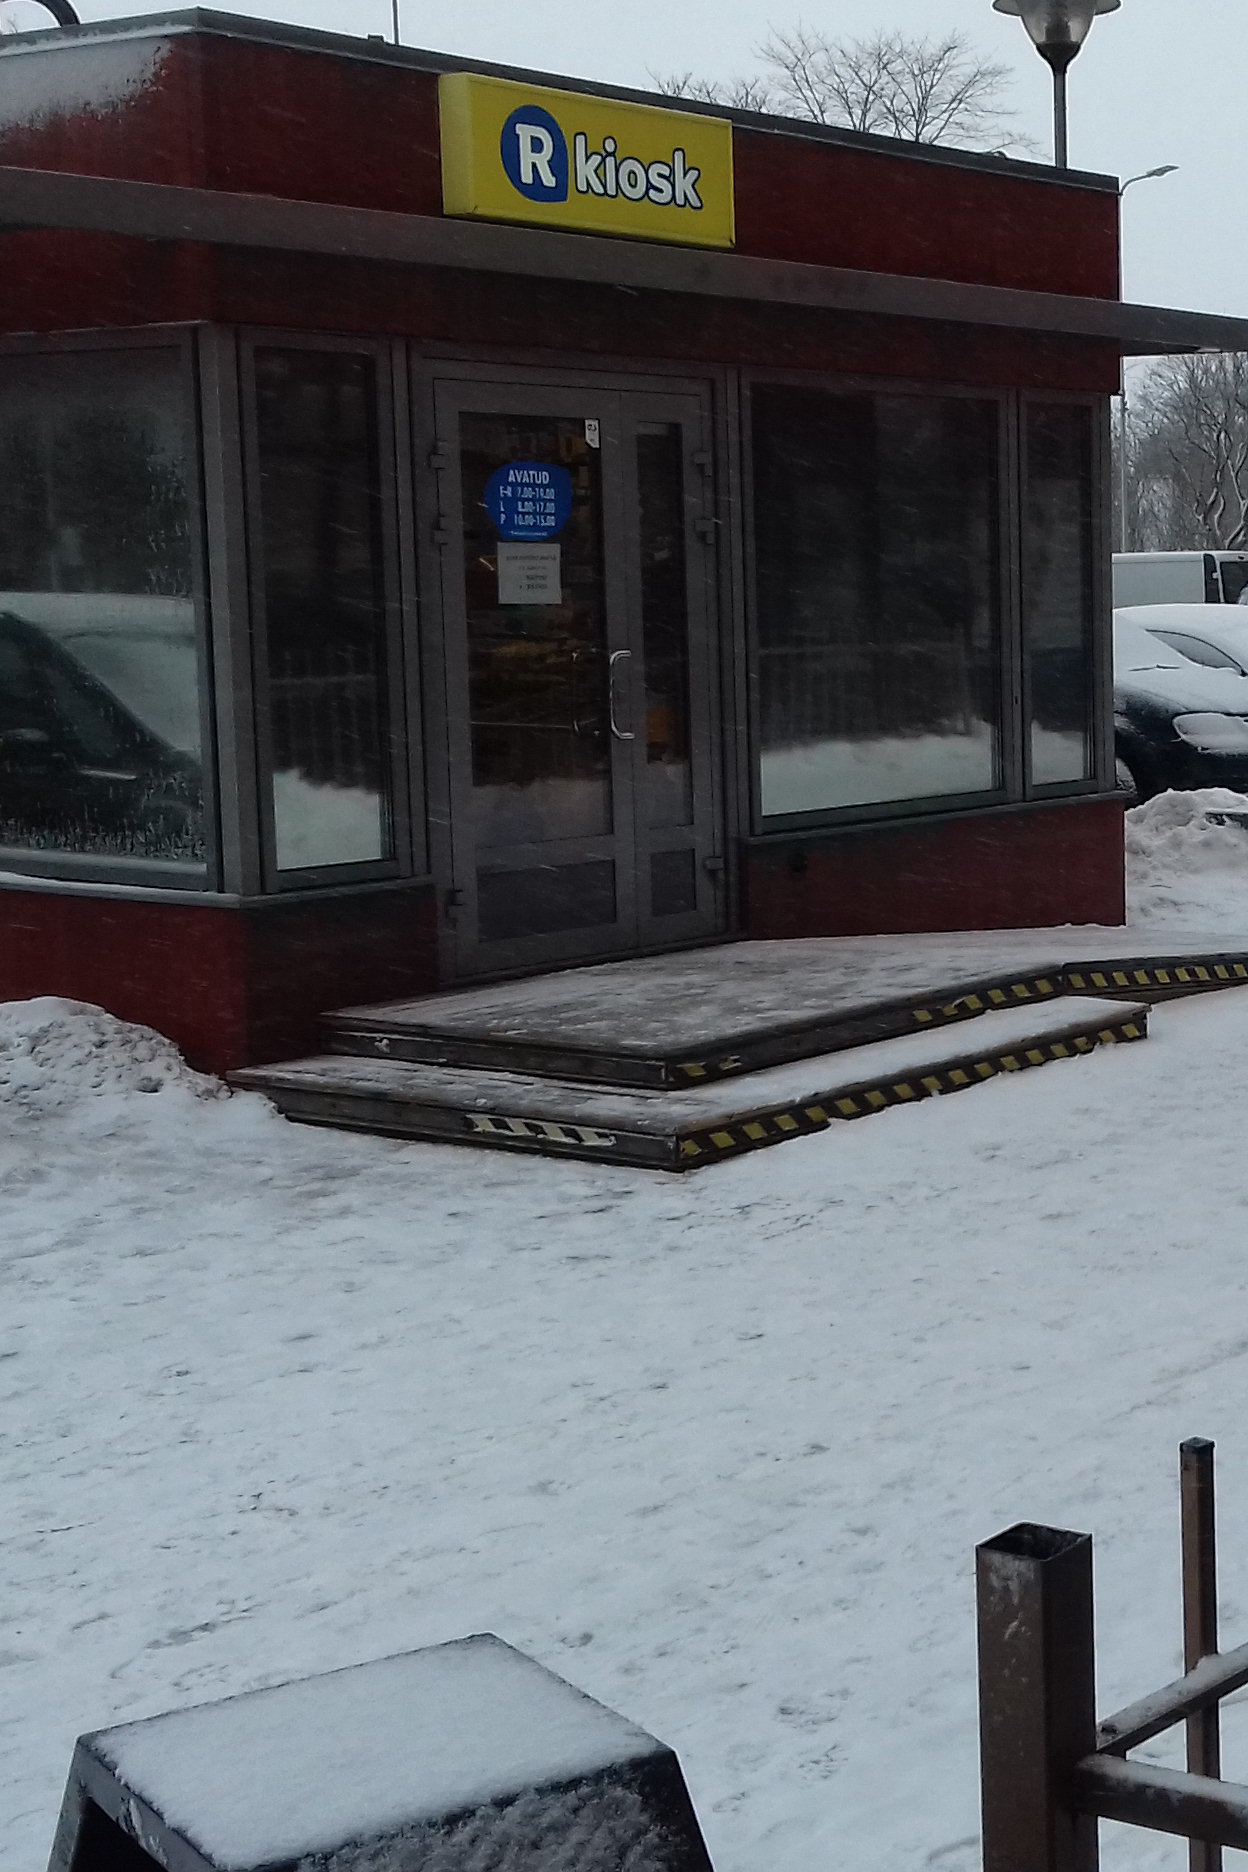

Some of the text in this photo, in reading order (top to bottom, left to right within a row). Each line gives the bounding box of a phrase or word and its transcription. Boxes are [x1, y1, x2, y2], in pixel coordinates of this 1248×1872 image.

[515, 122, 704, 210] R kiosk
[508, 469, 550, 484] AVATUD
[499, 486, 513, 498] E-R
[500, 500, 505, 512] L
[500, 514, 506, 525] P
